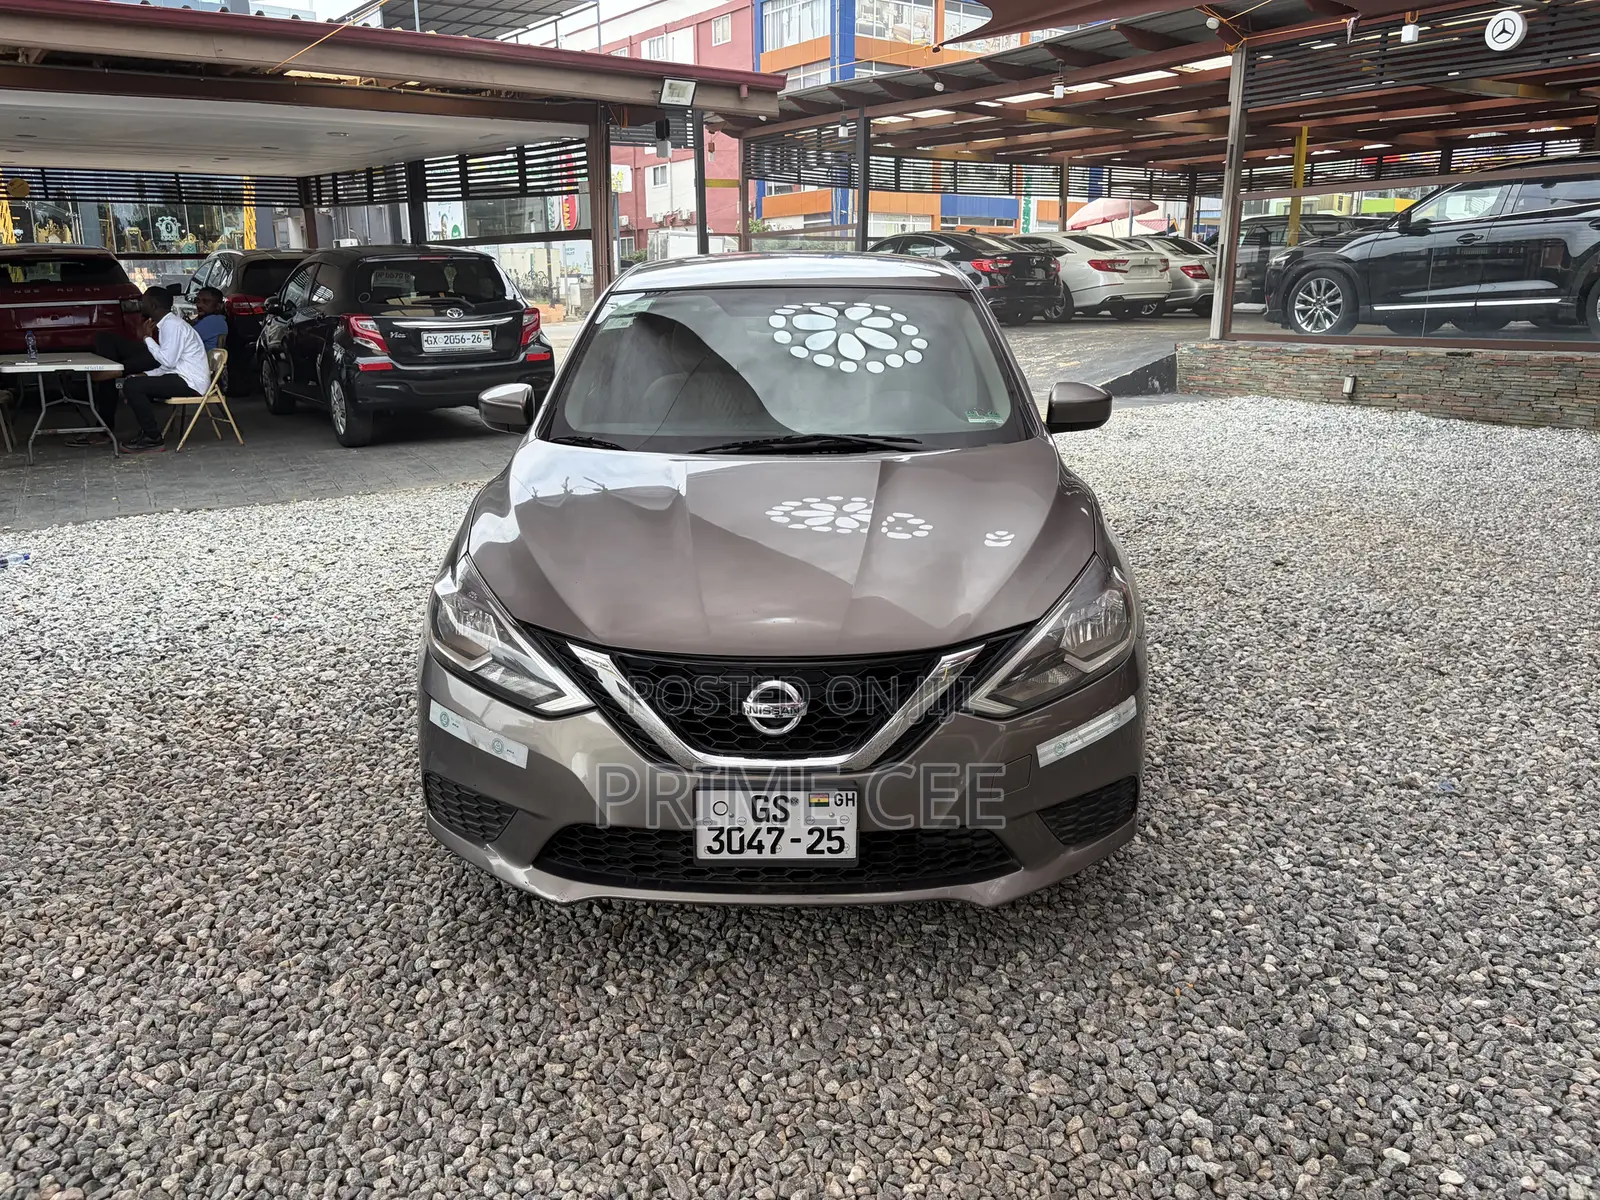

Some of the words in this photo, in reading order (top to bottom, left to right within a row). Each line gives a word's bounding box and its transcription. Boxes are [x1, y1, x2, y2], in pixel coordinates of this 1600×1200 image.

[426, 335, 438, 345] GX
[444, 333, 482, 345] 2056-26
[749, 705, 800, 715] NISSAN
[834, 792, 855, 807] GH
[751, 794, 790, 823] GS
[706, 826, 846, 855] 3047-25
